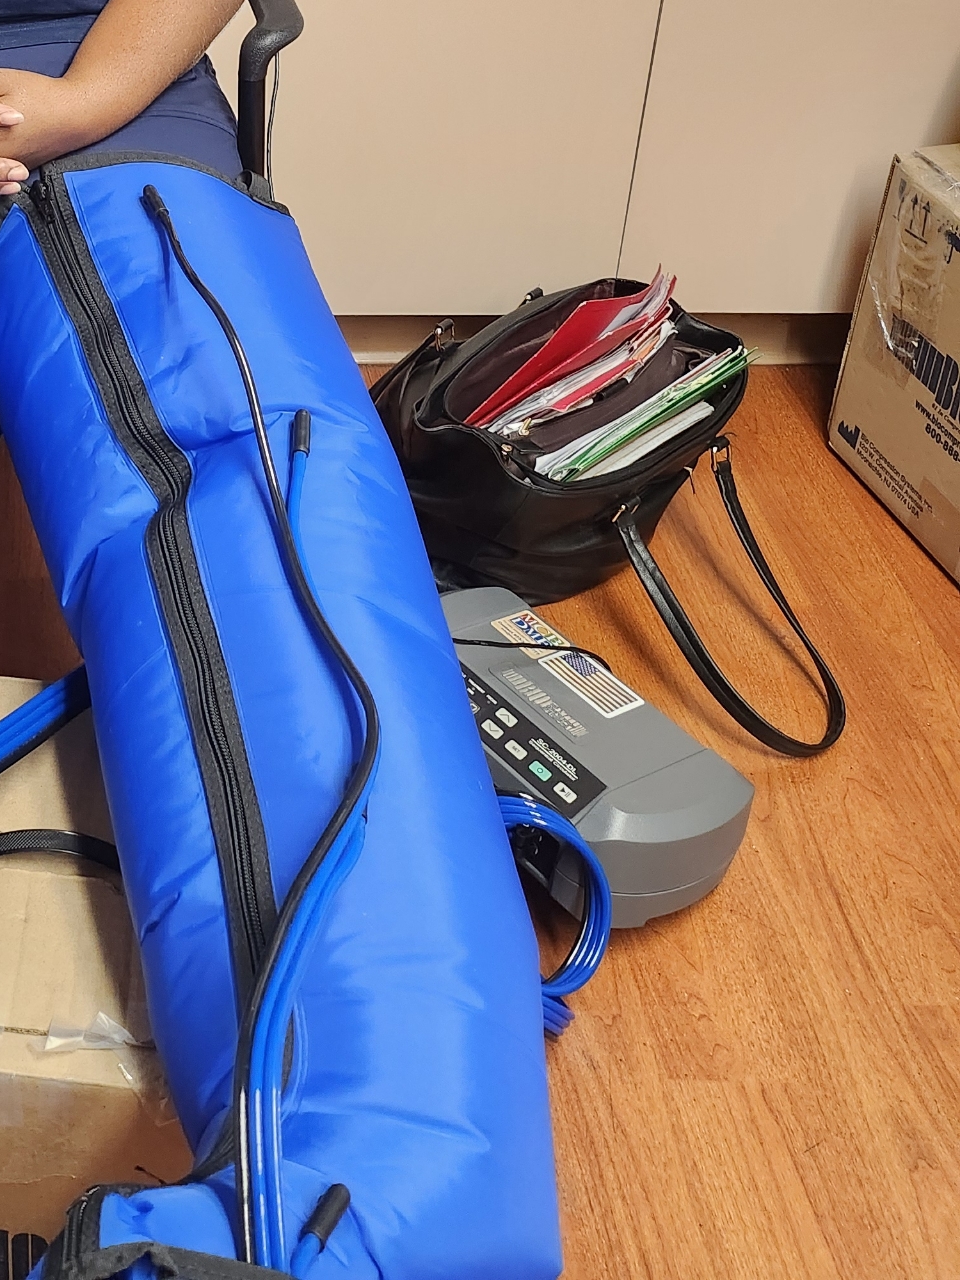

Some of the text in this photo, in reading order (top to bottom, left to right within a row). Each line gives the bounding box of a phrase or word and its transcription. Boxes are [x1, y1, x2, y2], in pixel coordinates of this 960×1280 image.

[935, 354, 960, 423] BI
[915, 399, 960, 450] www.biocompr
[869, 441, 901, 478] Compression
[890, 485, 908, 506] 07074
[907, 501, 920, 519] USA
[536, 738, 576, 774] SC-2004-DL
